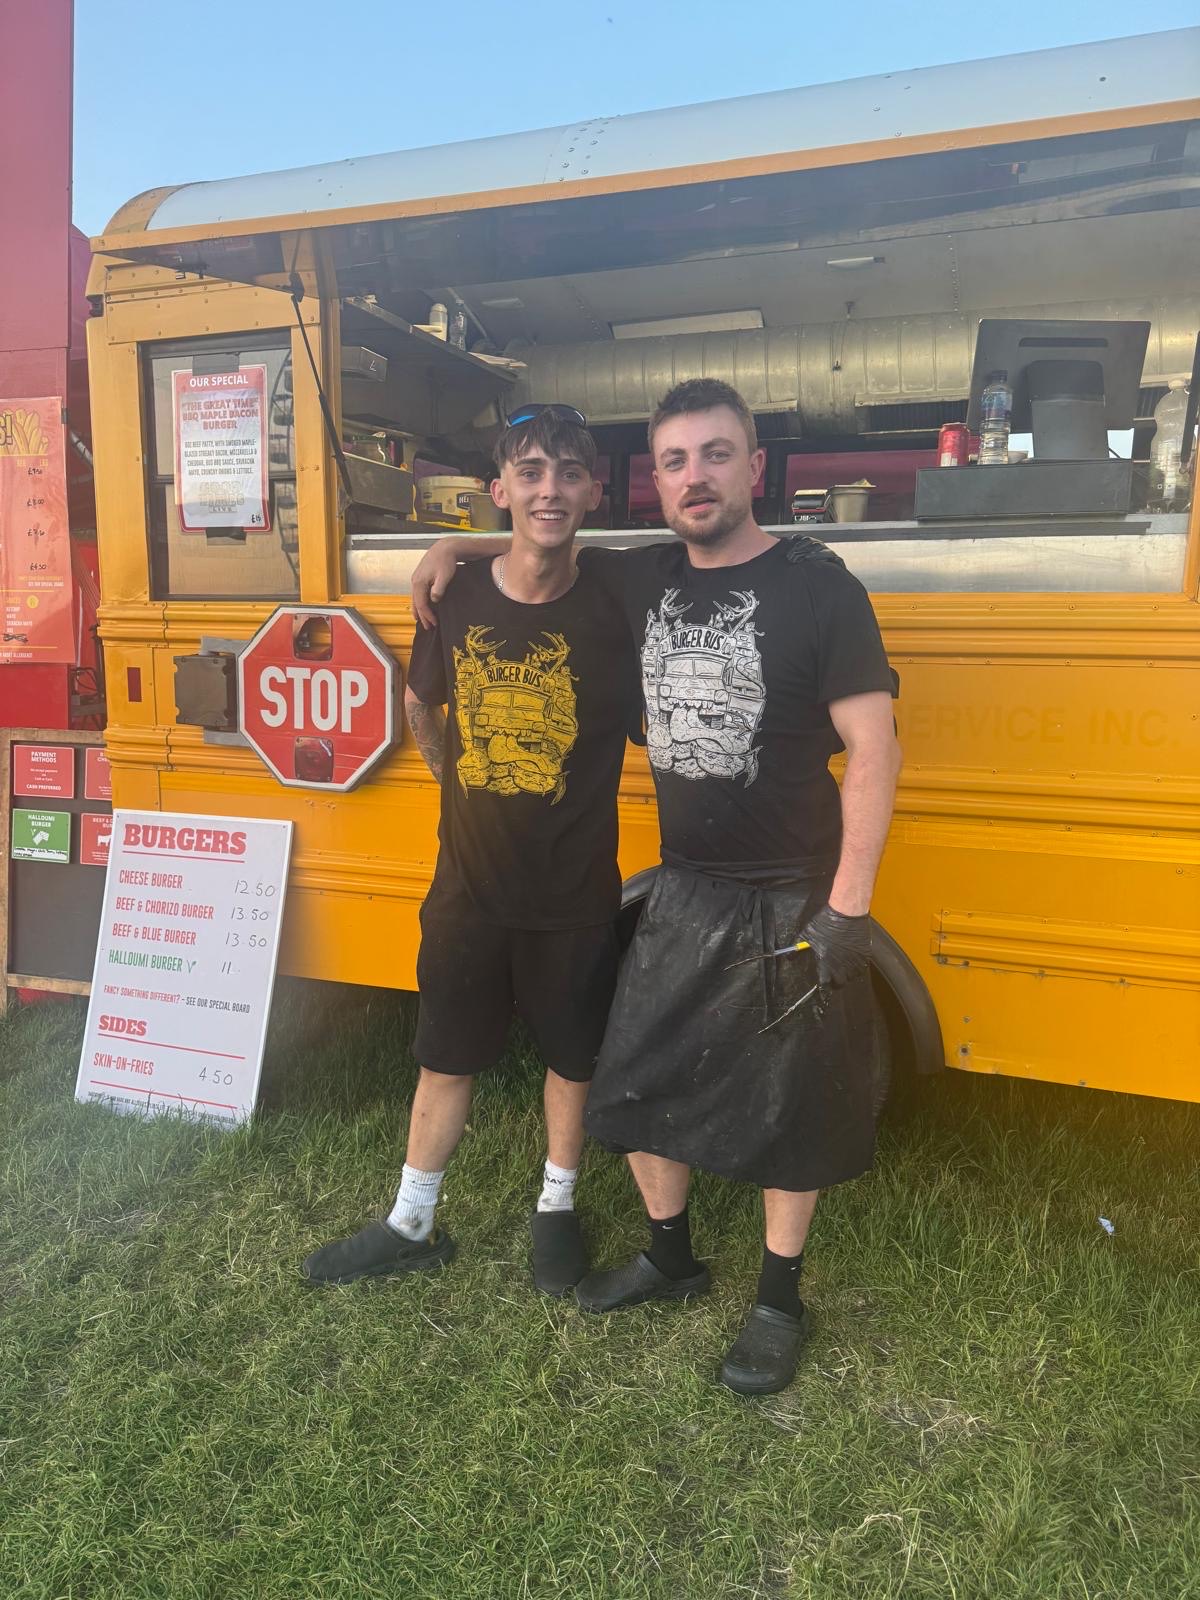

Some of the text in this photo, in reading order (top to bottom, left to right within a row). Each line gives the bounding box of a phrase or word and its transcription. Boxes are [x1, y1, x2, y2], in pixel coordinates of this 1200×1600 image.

[190, 375, 249, 388] OUR SPECIAL
[183, 409, 259, 422] BBQ MAPLE BACON
[203, 399, 230, 410] GREAT
[203, 420, 237, 430] BURGER
[671, 628, 724, 651] BURGER BUS
[486, 666, 544, 688] BURGER BUS
[260, 666, 369, 733] STOP
[908, 703, 1181, 748] ERVICE INC.
[28, 814, 55, 822] HALLOUMI
[123, 823, 247, 855] BURGERS
[119, 869, 183, 889] CHEESE BURGER
[116, 897, 214, 920] BEEF & CHORIZO BURGER
[112, 923, 197, 946] BEEF & BLUE BURGER
[108, 950, 183, 972] HALLOUMI BURGER
[104, 984, 119, 995] FANCY
[120, 986, 149, 1000] SOMETHING
[149, 990, 181, 1004] DIFFERENT?
[186, 996, 197, 1006] SEE
[197, 997, 209, 1008] OUR
[209, 999, 231, 1011] SPECIAL
[232, 1002, 251, 1014] BOARD
[98, 1014, 148, 1037] SIDES
[93, 1052, 154, 1076] SKIN-ON-FRIES
